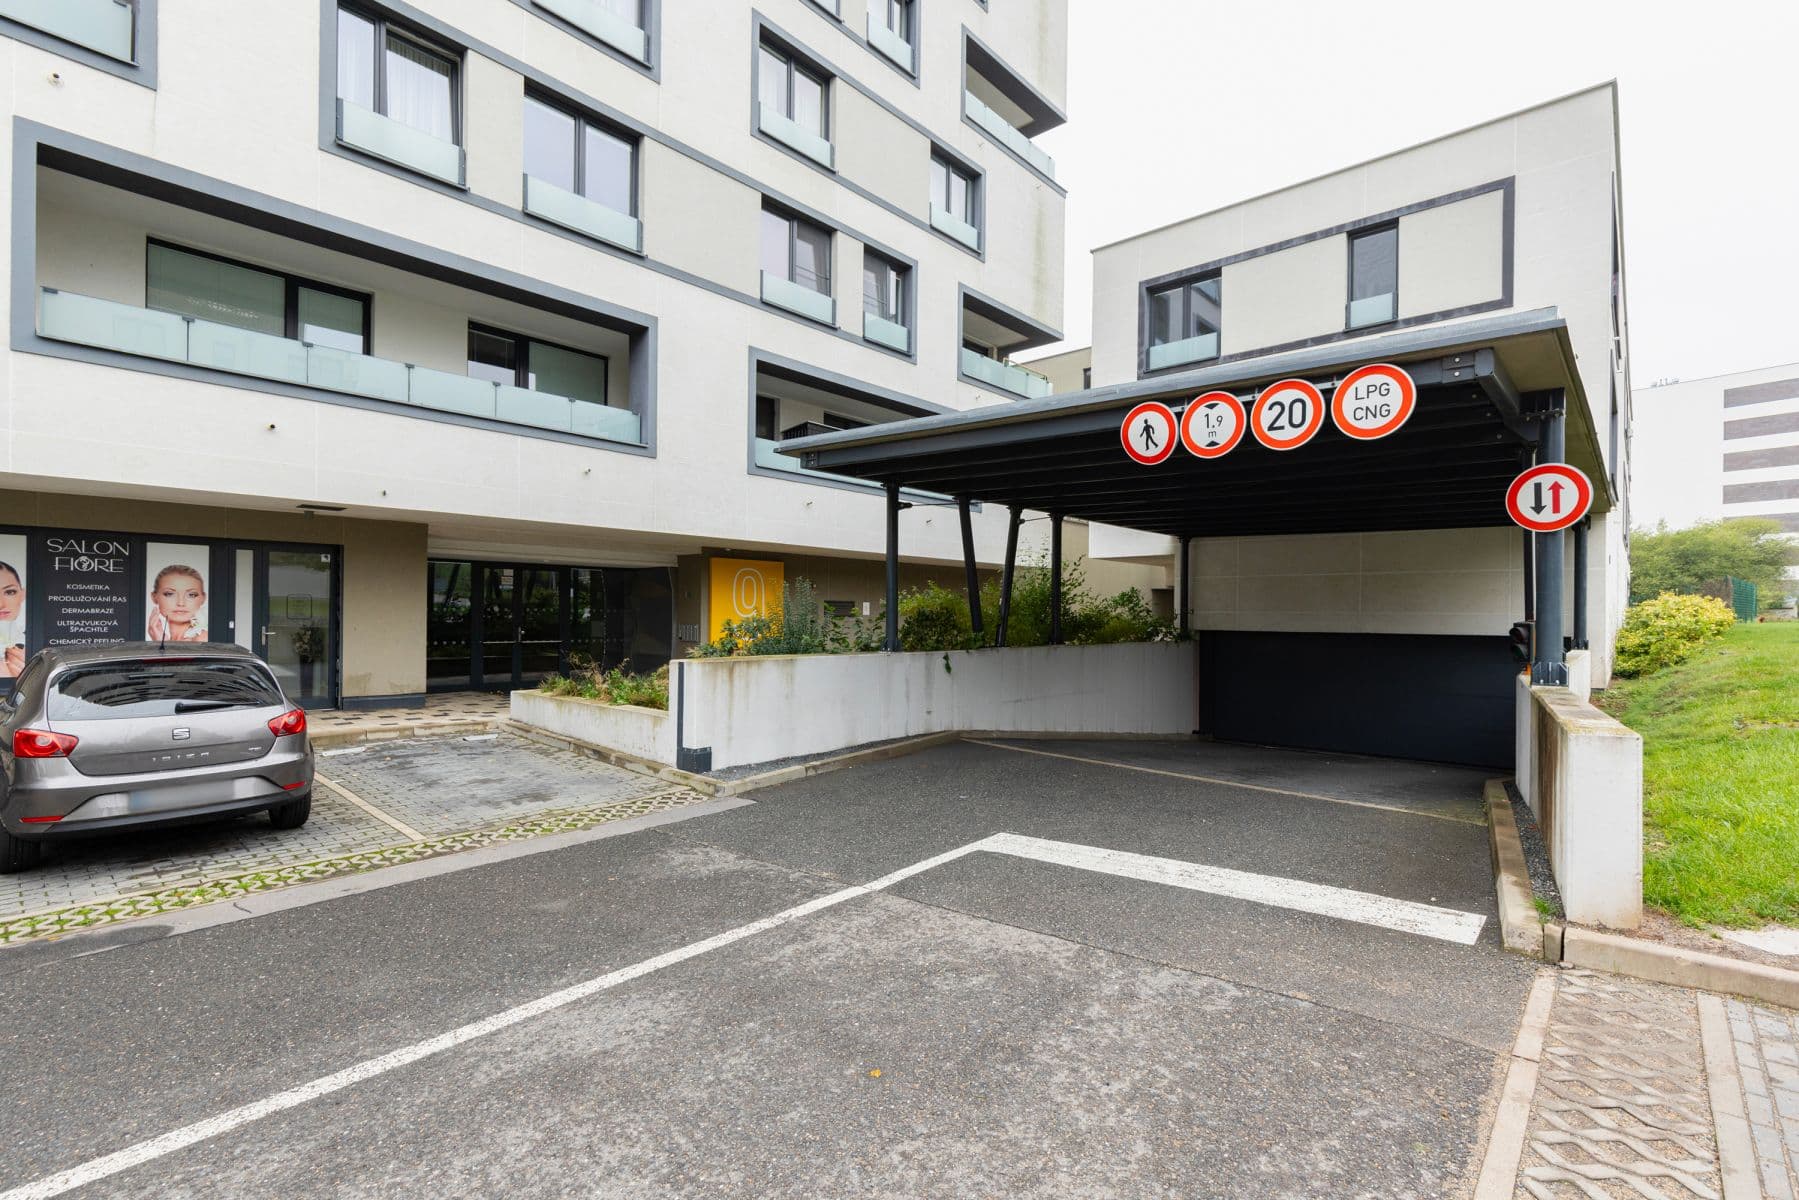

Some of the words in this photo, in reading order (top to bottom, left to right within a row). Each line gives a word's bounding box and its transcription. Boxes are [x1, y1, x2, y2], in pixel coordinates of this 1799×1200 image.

[1355, 382, 1391, 400] LPG
[1267, 398, 1307, 432] 20
[1353, 403, 1391, 421] CNG
[1204, 413, 1223, 429] 1.9
[1208, 430, 1217, 438] m
[47, 538, 130, 556] SALON
[53, 556, 124, 573] FIORE
[66, 583, 110, 591] KOSMETIKA
